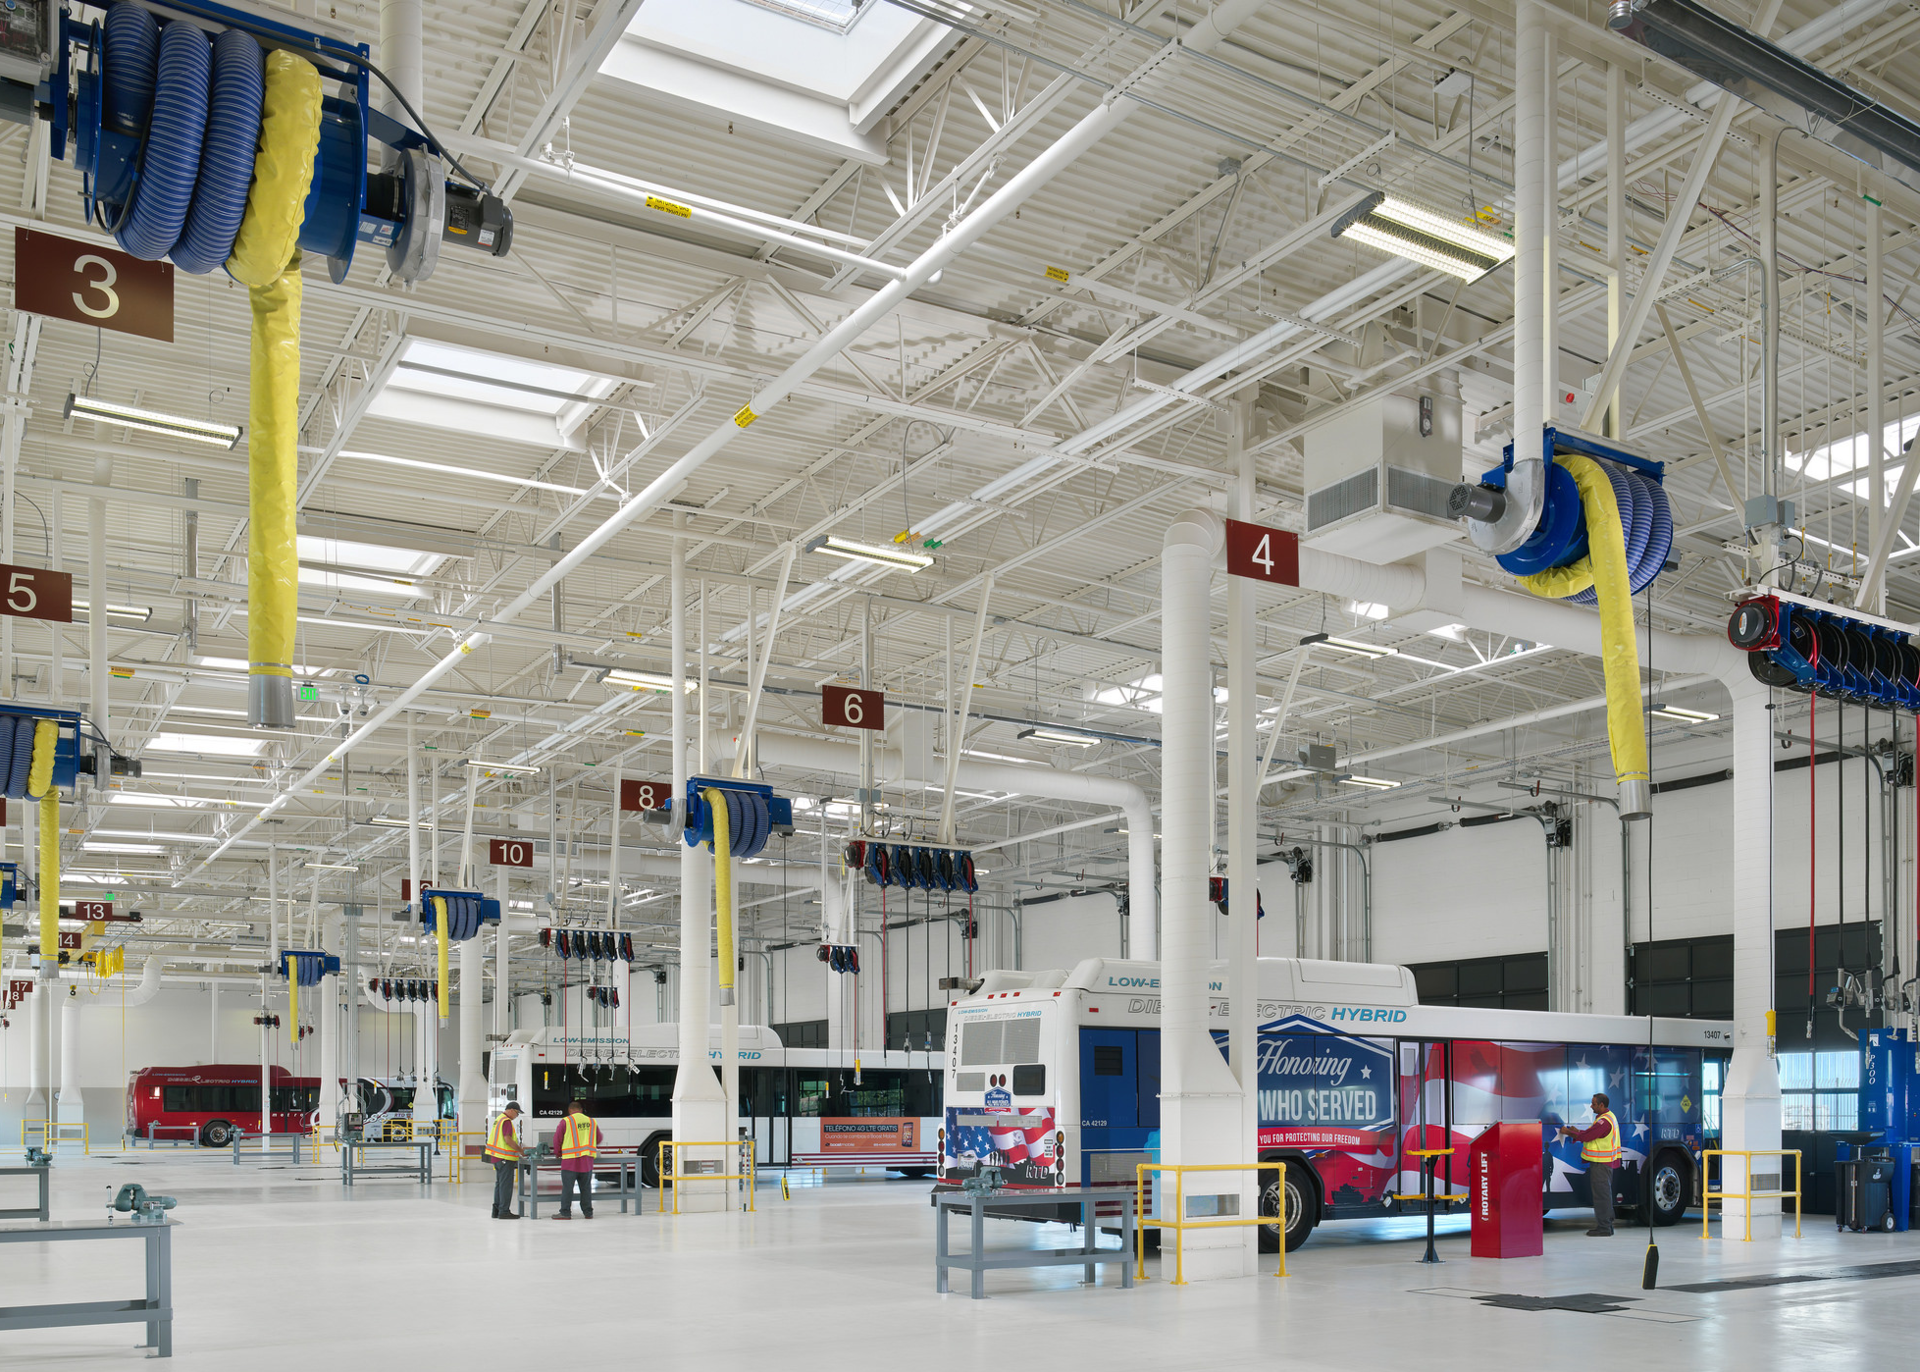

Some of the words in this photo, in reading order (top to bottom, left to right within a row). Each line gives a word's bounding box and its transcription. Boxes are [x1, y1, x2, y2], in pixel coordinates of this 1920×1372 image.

[72, 254, 120, 318] 3
[1252, 534, 1274, 575] 4
[7, 572, 37, 612] 5
[300, 687, 317, 700] EXIT
[844, 694, 863, 724] 6
[639, 785, 654, 810] 8
[499, 844, 523, 864] 10
[83, 904, 104, 920] 13
[59, 934, 74, 947] 14
[15, 982, 28, 991] 17
[1331, 1007, 1407, 1023] HYBRID
[1704, 1031, 1721, 1039] 13407
[709, 1051, 761, 1059] HYRID
[1257, 1038, 1352, 1086] Honoring
[1259, 1090, 1302, 1121] WHO
[1308, 1090, 1376, 1121] SERVED
[1259, 1135, 1271, 1144] YOU
[1273, 1134, 1284, 1143] FOR
[1285, 1132, 1321, 1142] PROTECTING
[1322, 1132, 1333, 1143] OUR
[1334, 1133, 1360, 1145] FREEDOM
[1026, 1164, 1050, 1179] RTD
